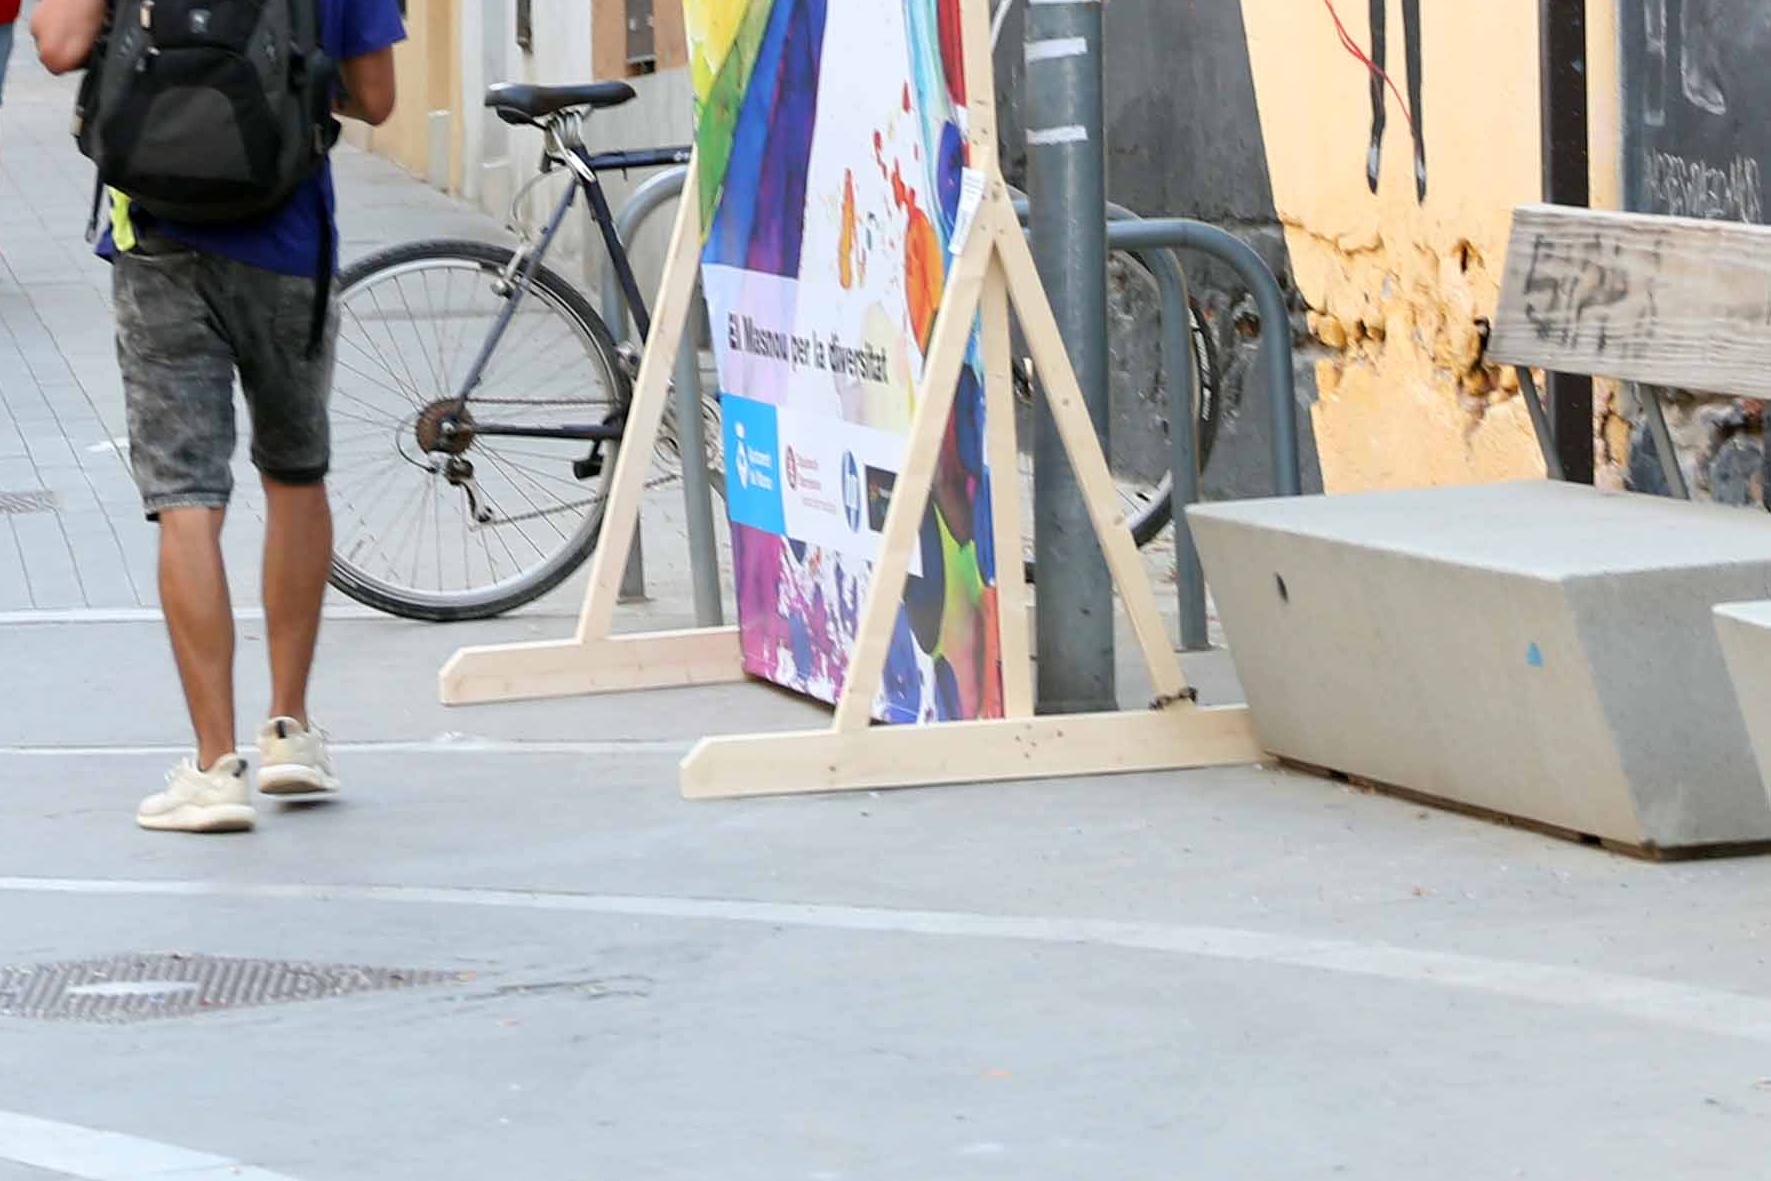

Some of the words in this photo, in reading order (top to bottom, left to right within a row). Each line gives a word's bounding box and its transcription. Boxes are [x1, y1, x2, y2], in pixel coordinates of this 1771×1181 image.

[728, 311, 741, 351] El
[741, 314, 789, 362] Masnou
[790, 333, 811, 372] per
[811, 328, 827, 370] la
[828, 331, 890, 384] diversitat
